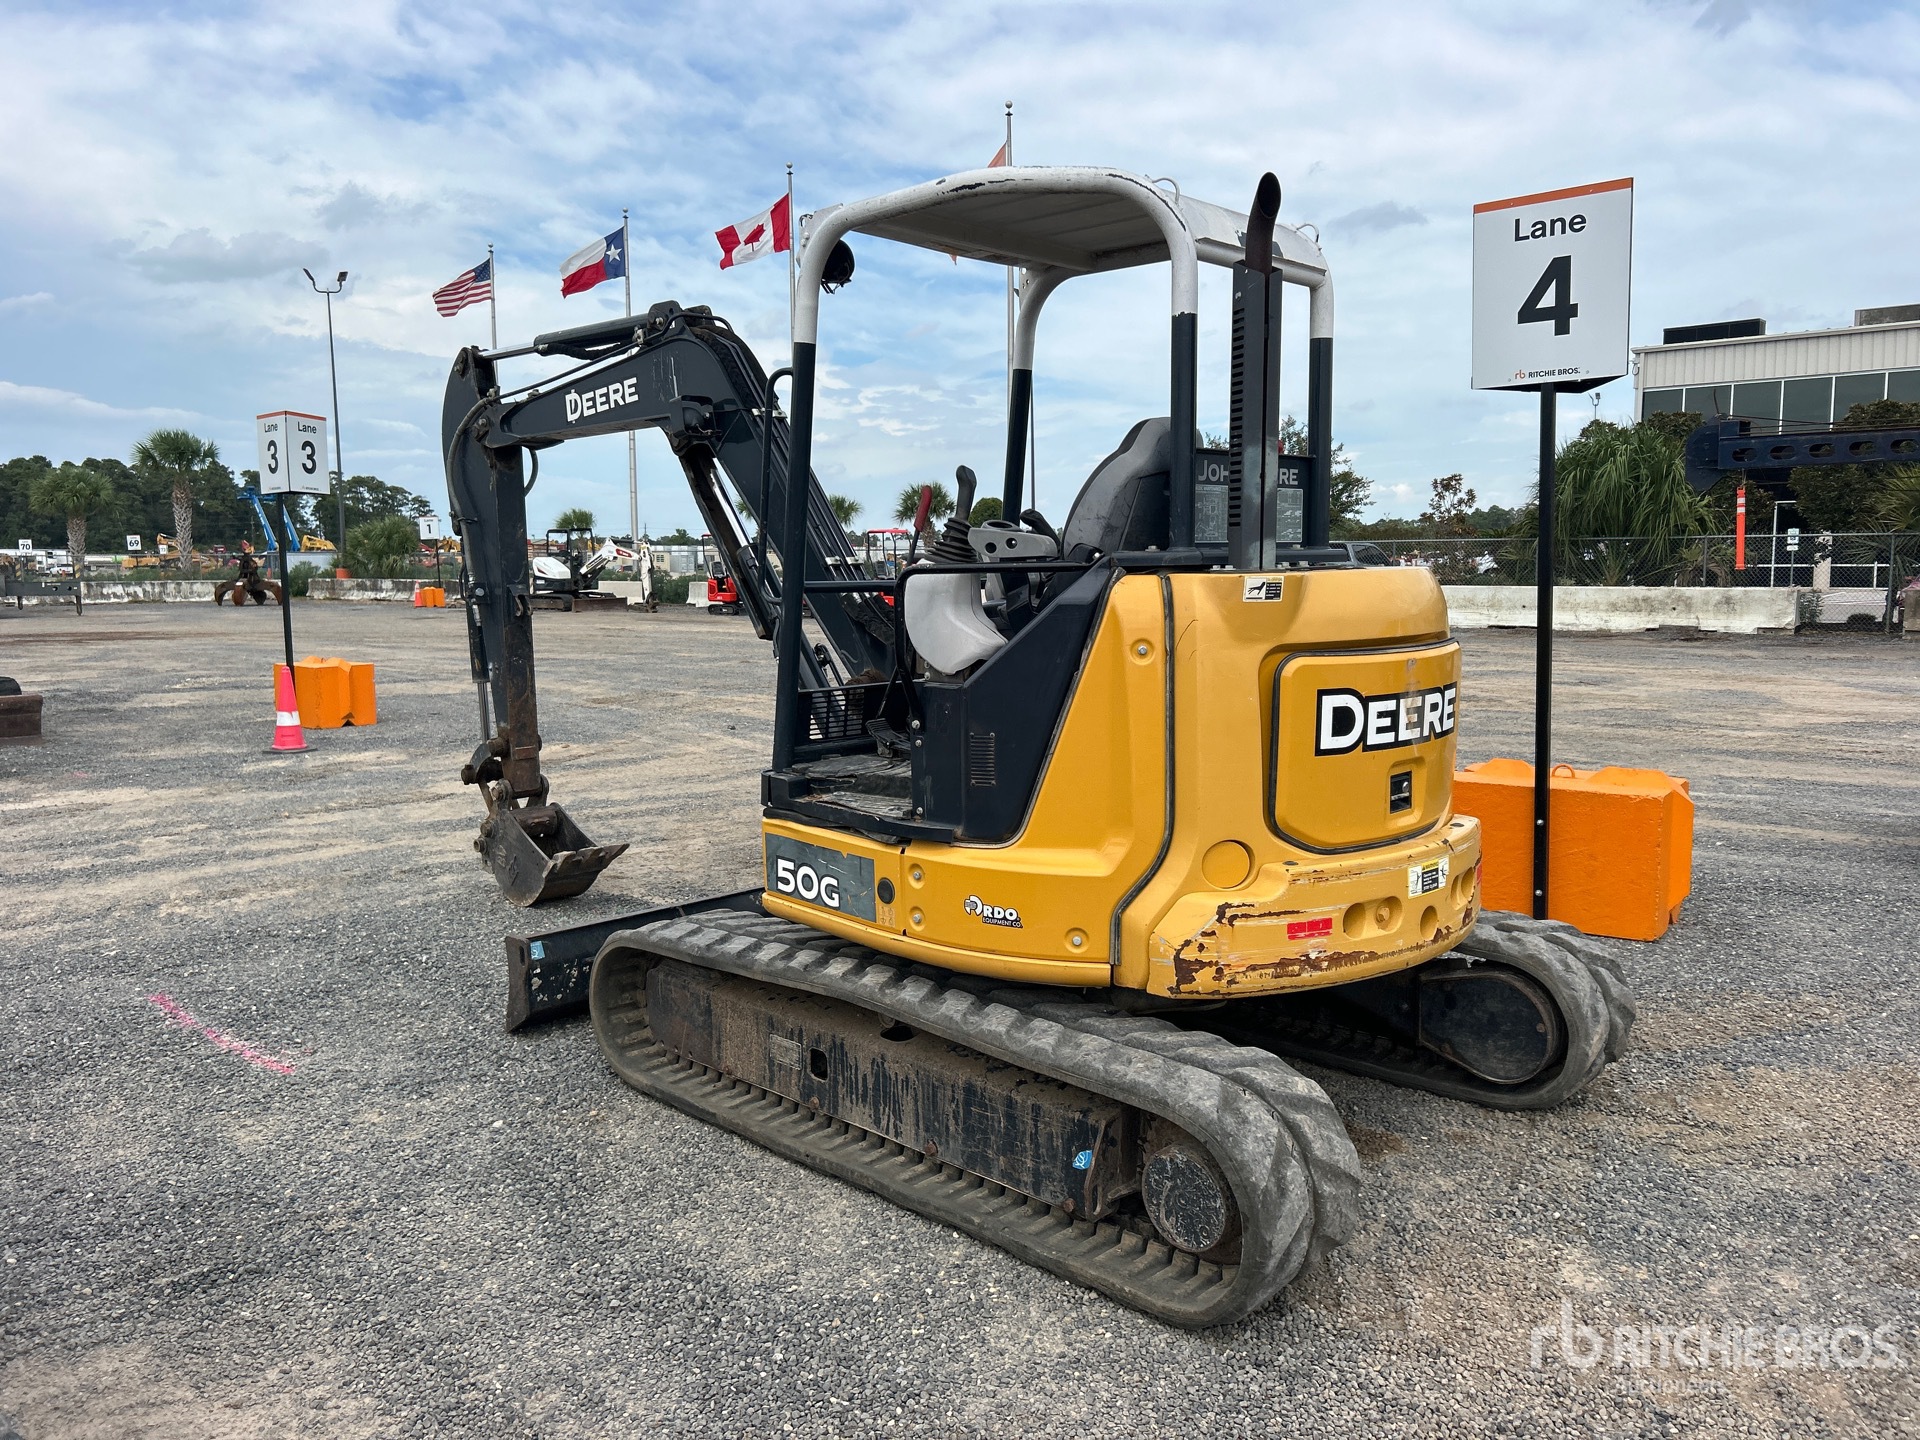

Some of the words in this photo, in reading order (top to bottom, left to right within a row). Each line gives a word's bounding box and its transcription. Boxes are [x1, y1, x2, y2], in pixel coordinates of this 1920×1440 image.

[1514, 214, 1587, 242] Lane
[1517, 254, 1579, 337] 4
[1528, 369, 1557, 379] RITCHIE
[564, 376, 640, 423] DEERE
[264, 422, 279, 433] Lane
[297, 421, 318, 434] Lane
[267, 439, 279, 475] 3
[301, 440, 317, 475] 3
[1198, 459, 1229, 482] JOH
[426, 524, 432, 534] 1
[20, 543, 31, 551] 70
[128, 539, 140, 547] 69
[1318, 685, 1458, 752] DEERE
[776, 857, 841, 909] 50G
[982, 917, 1012, 927] EQUIPMENT
